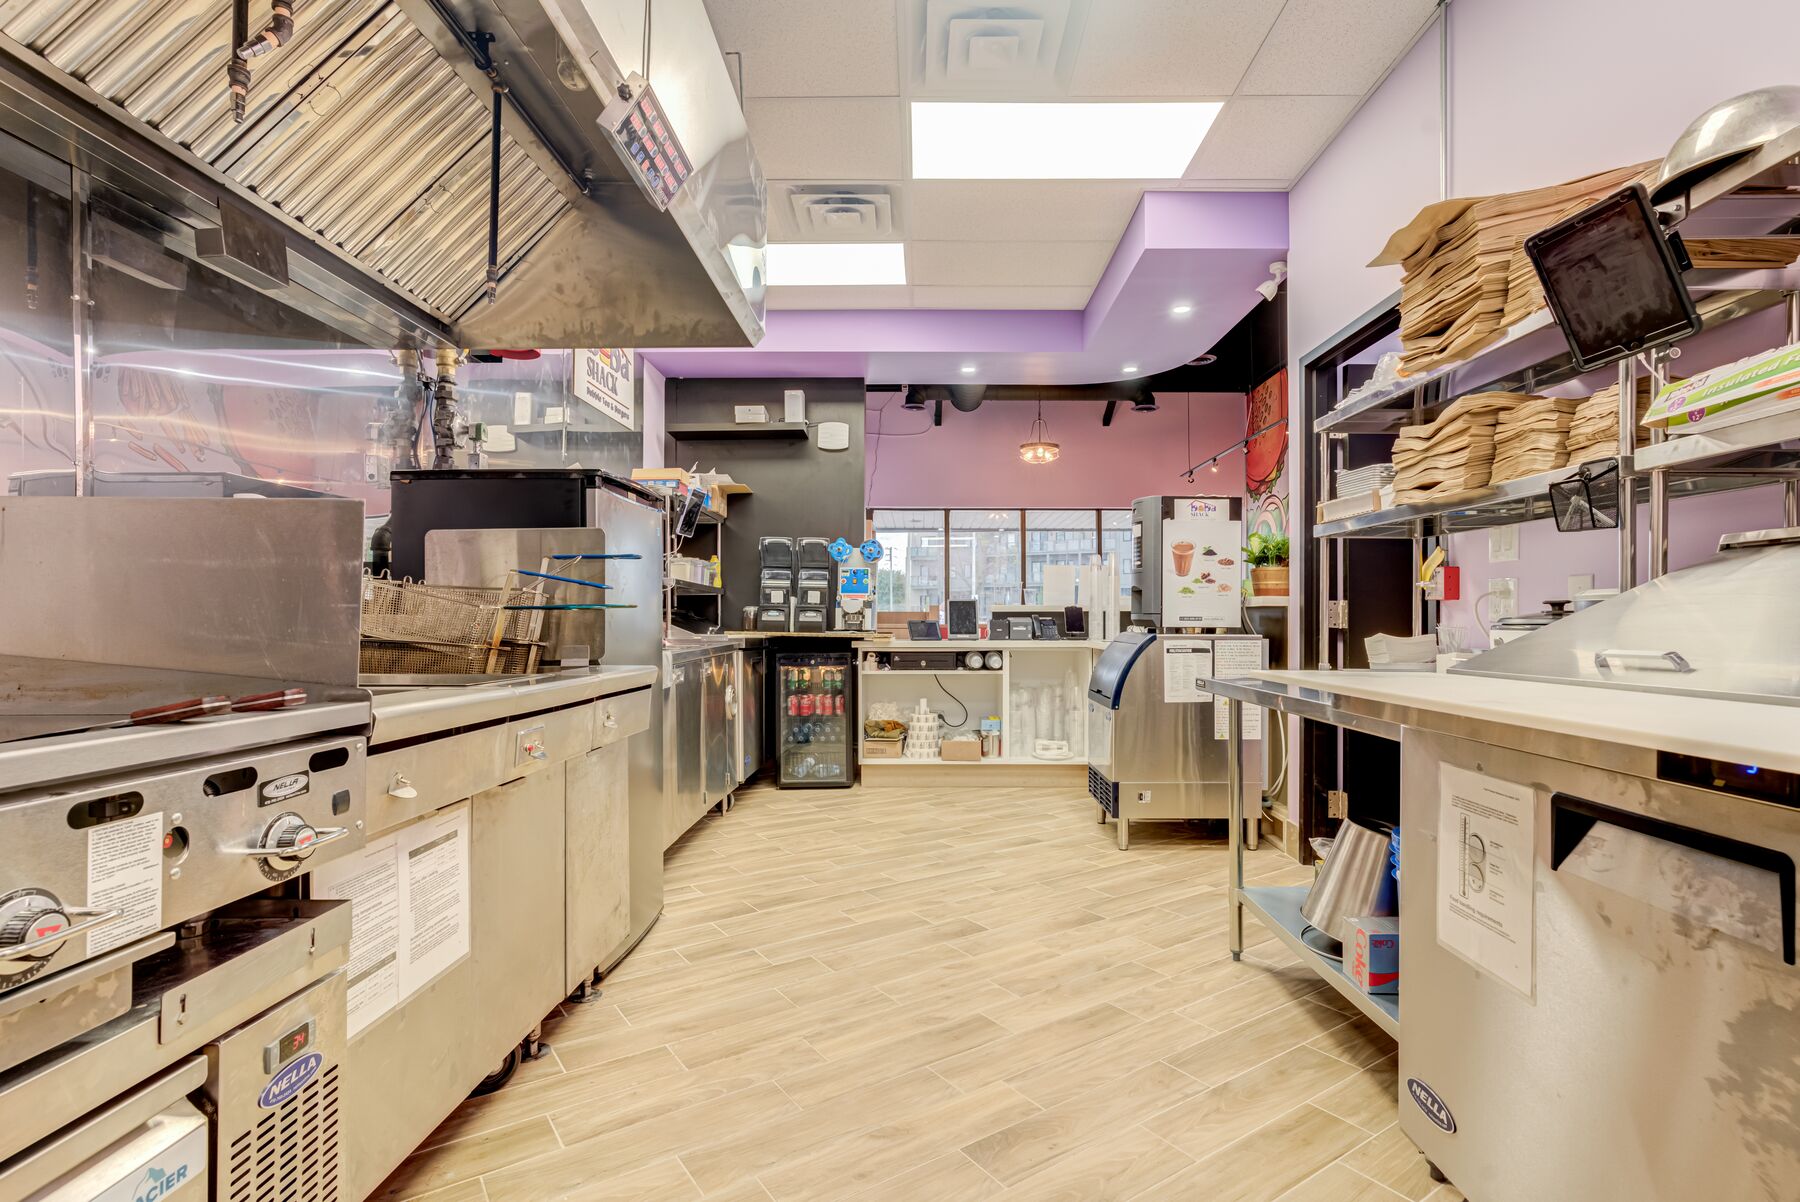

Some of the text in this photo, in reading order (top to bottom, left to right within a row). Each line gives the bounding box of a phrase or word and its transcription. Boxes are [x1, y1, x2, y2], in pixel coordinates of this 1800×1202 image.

[586, 356, 618, 396] SHACK
[273, 778, 299, 791] NELLA
[1352, 927, 1367, 988] Coke
[293, 1032, 305, 1051] 34
[269, 1056, 317, 1100] NELLA
[1412, 1081, 1448, 1125] NELLA
